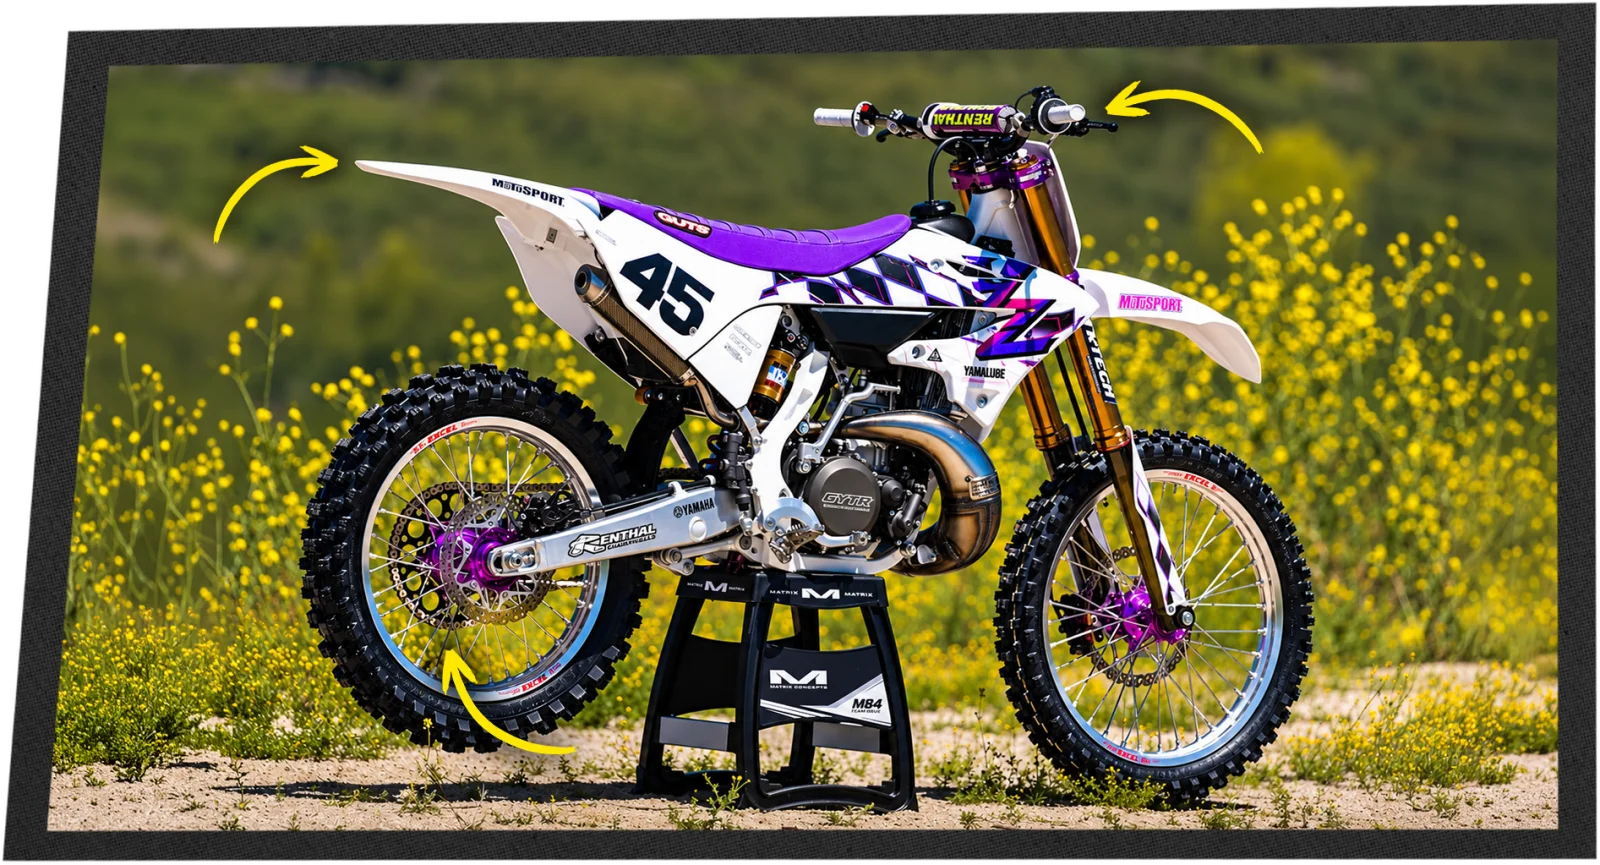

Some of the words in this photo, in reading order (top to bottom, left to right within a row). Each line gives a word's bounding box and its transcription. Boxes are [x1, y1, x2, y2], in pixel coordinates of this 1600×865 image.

[657, 211, 711, 235] GUTS
[619, 253, 715, 337] 45
[1118, 293, 1183, 313] MOTOSPORT
[963, 365, 1006, 379] YAMALUBE
[427, 424, 458, 443] EXCEL
[682, 497, 715, 516] YAMAHA
[821, 492, 874, 507] GYTR
[567, 523, 657, 557] RENTHAL
[801, 588, 840, 599] M
[769, 669, 827, 685] M
